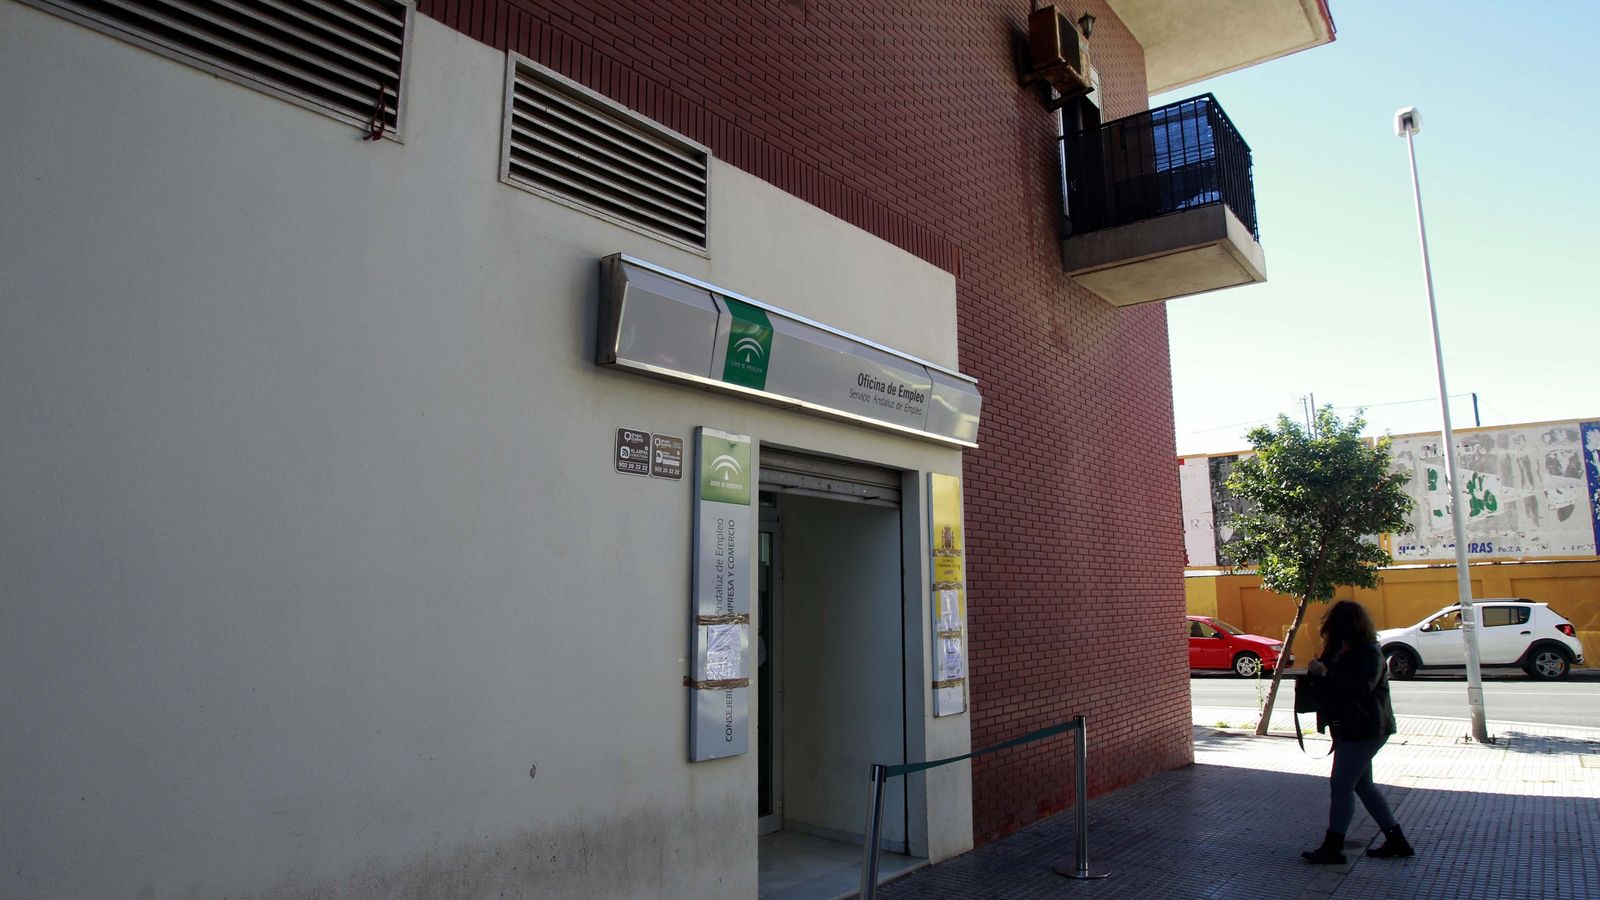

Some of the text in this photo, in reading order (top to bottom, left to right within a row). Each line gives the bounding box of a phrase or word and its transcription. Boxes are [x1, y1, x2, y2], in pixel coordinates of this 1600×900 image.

[849, 388, 923, 416] Servicio Andaluz de Empleo
[857, 372, 925, 404] Oficina de Empleo
[618, 461, 628, 469] 902
[714, 518, 725, 614] Andaluz de Empleo
[727, 519, 735, 614] MPRESA Y COMERCIO
